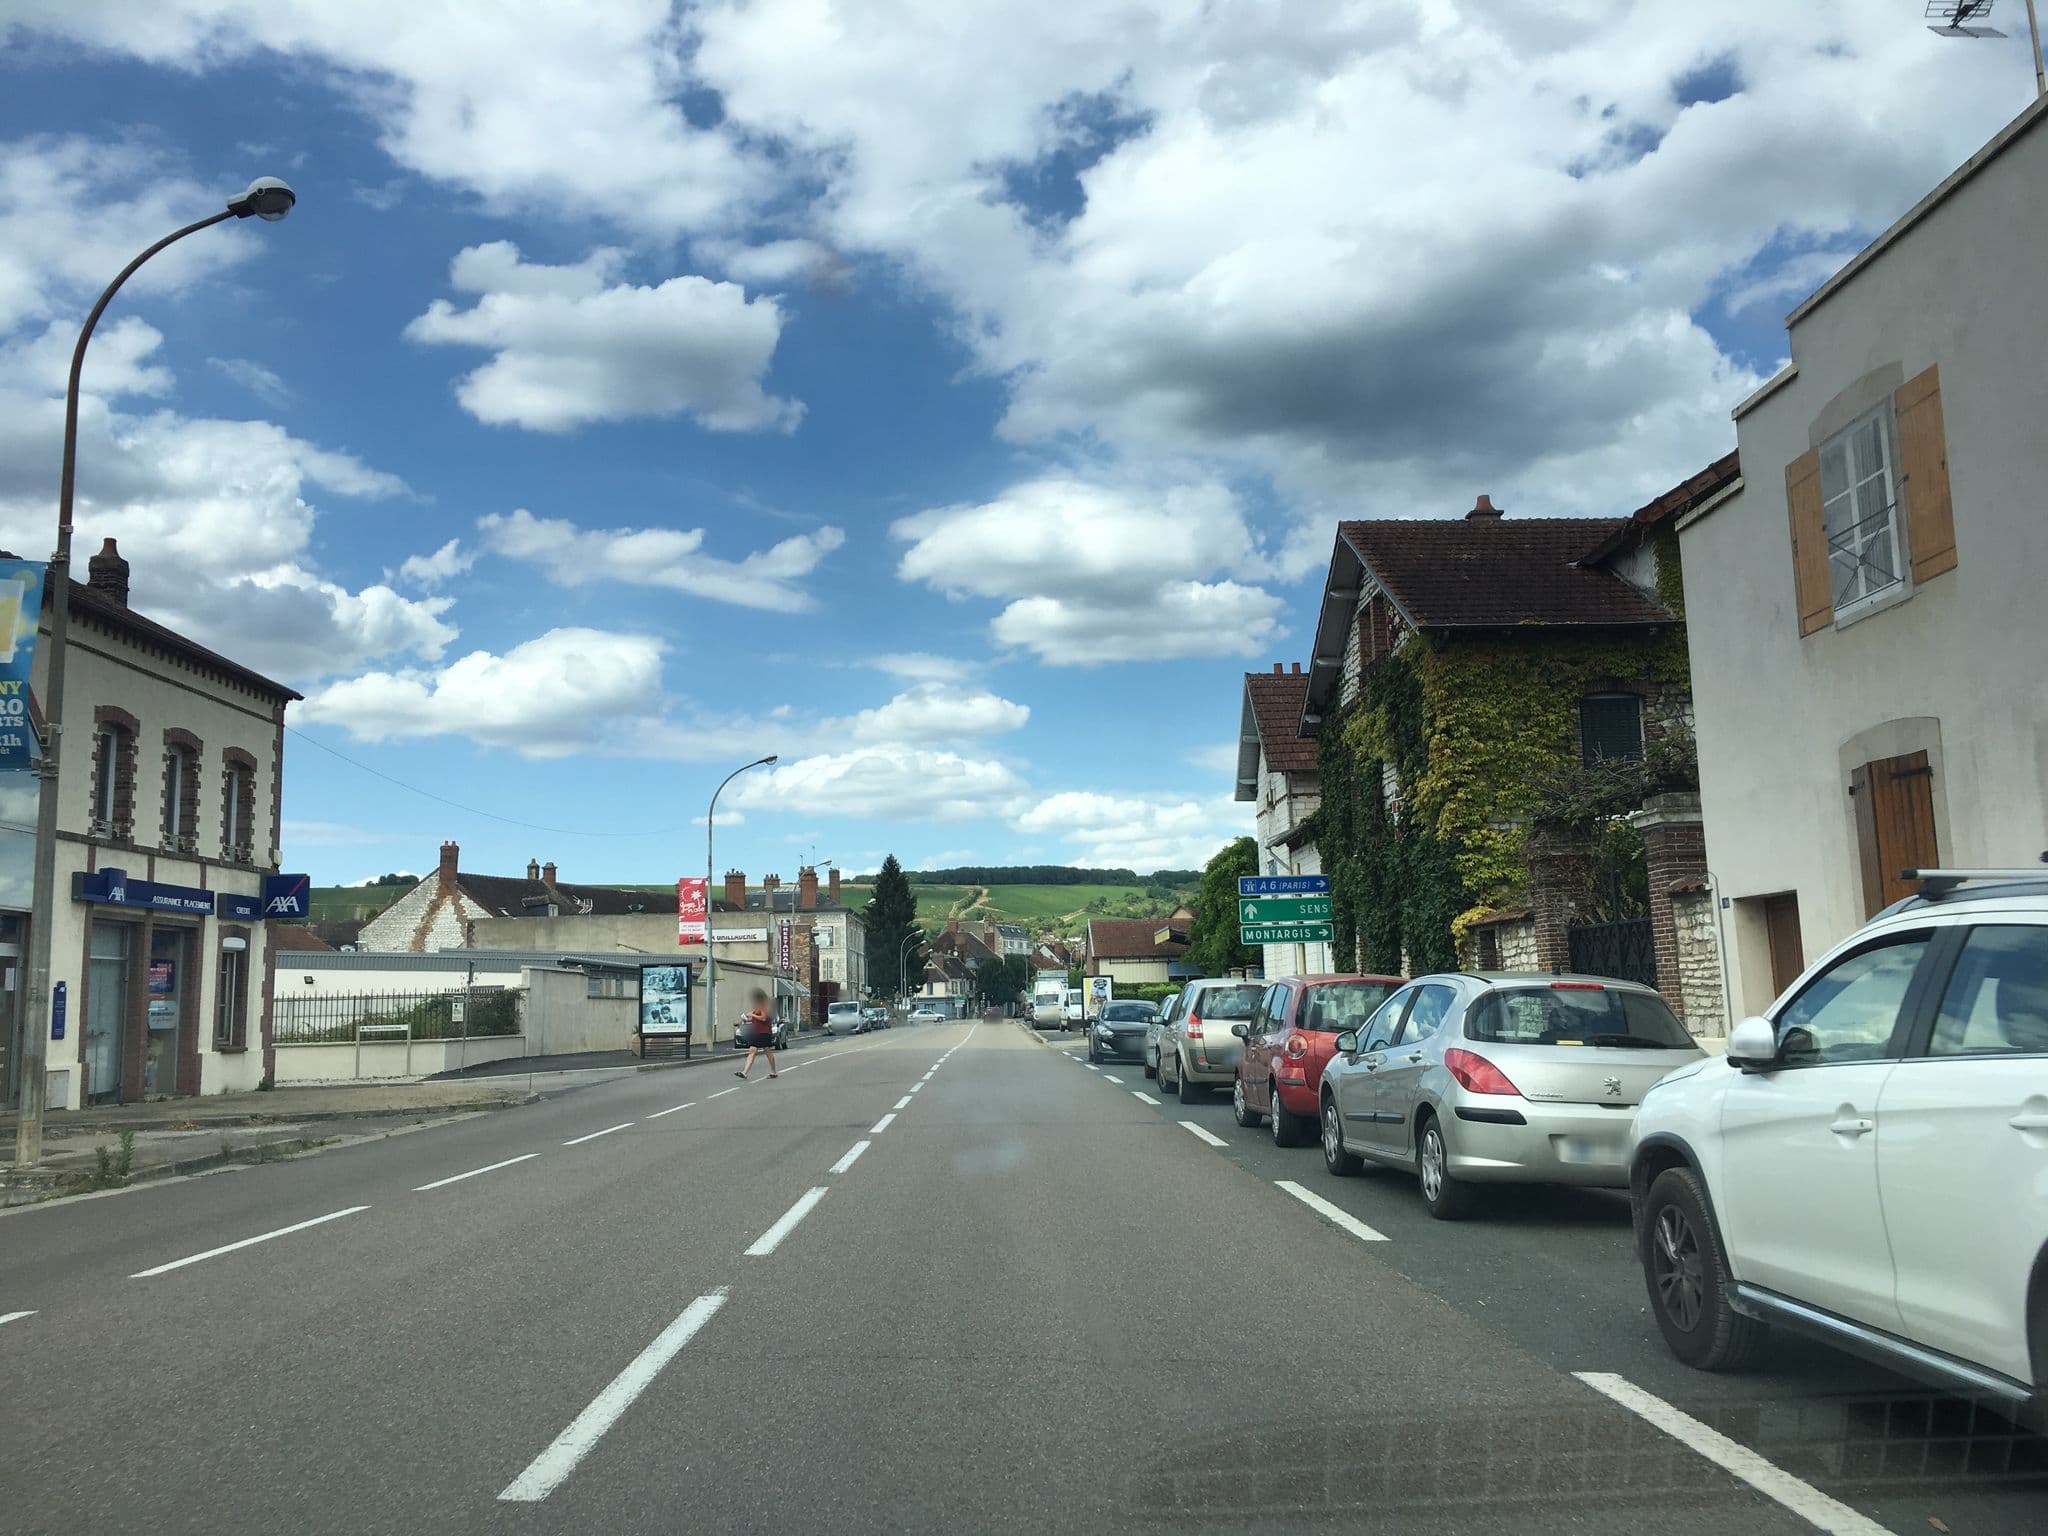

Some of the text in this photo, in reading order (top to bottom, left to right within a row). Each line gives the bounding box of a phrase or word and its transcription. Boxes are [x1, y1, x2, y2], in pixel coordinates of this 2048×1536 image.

[1279, 880, 1311, 891] (PARIS)
[108, 886, 125, 902] AXA
[152, 895, 211, 910] ASSURANCE PLACEMENT
[265, 896, 300, 913] AXA
[1299, 904, 1329, 914] SENS
[1245, 928, 1312, 940] MONTARGIS
